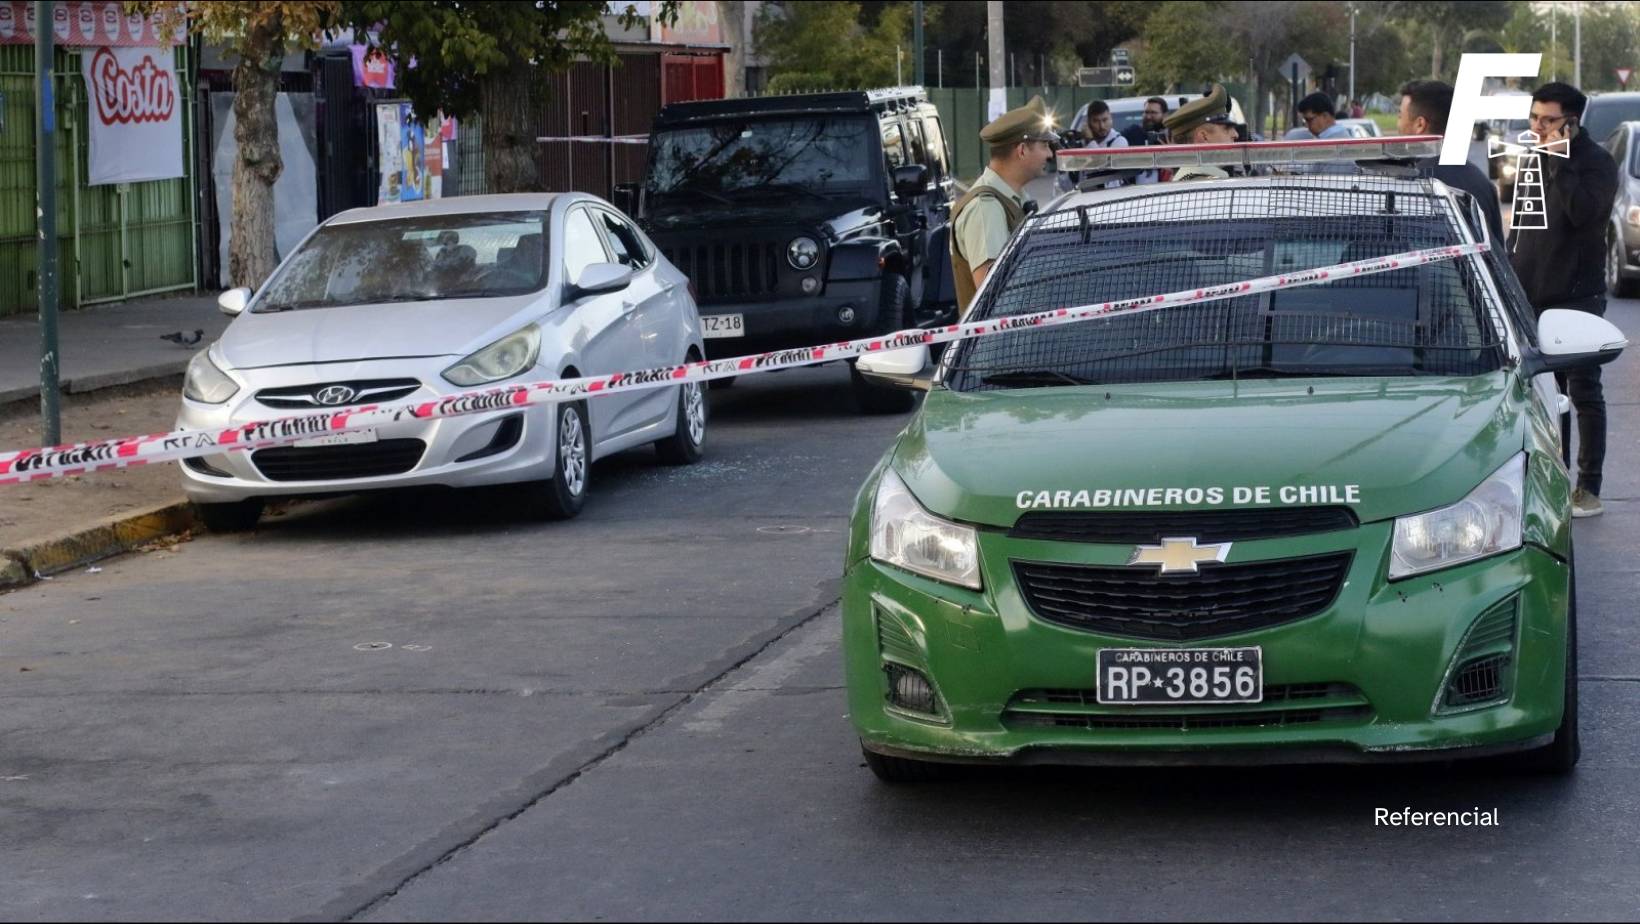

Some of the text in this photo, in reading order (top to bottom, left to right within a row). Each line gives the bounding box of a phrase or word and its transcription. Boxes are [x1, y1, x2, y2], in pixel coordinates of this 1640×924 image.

[91, 46, 174, 126] Costa
[1015, 485, 1361, 508] CARABINEROS DE CHILE
[1115, 651, 1243, 663] CARABINEROS DE CHILE
